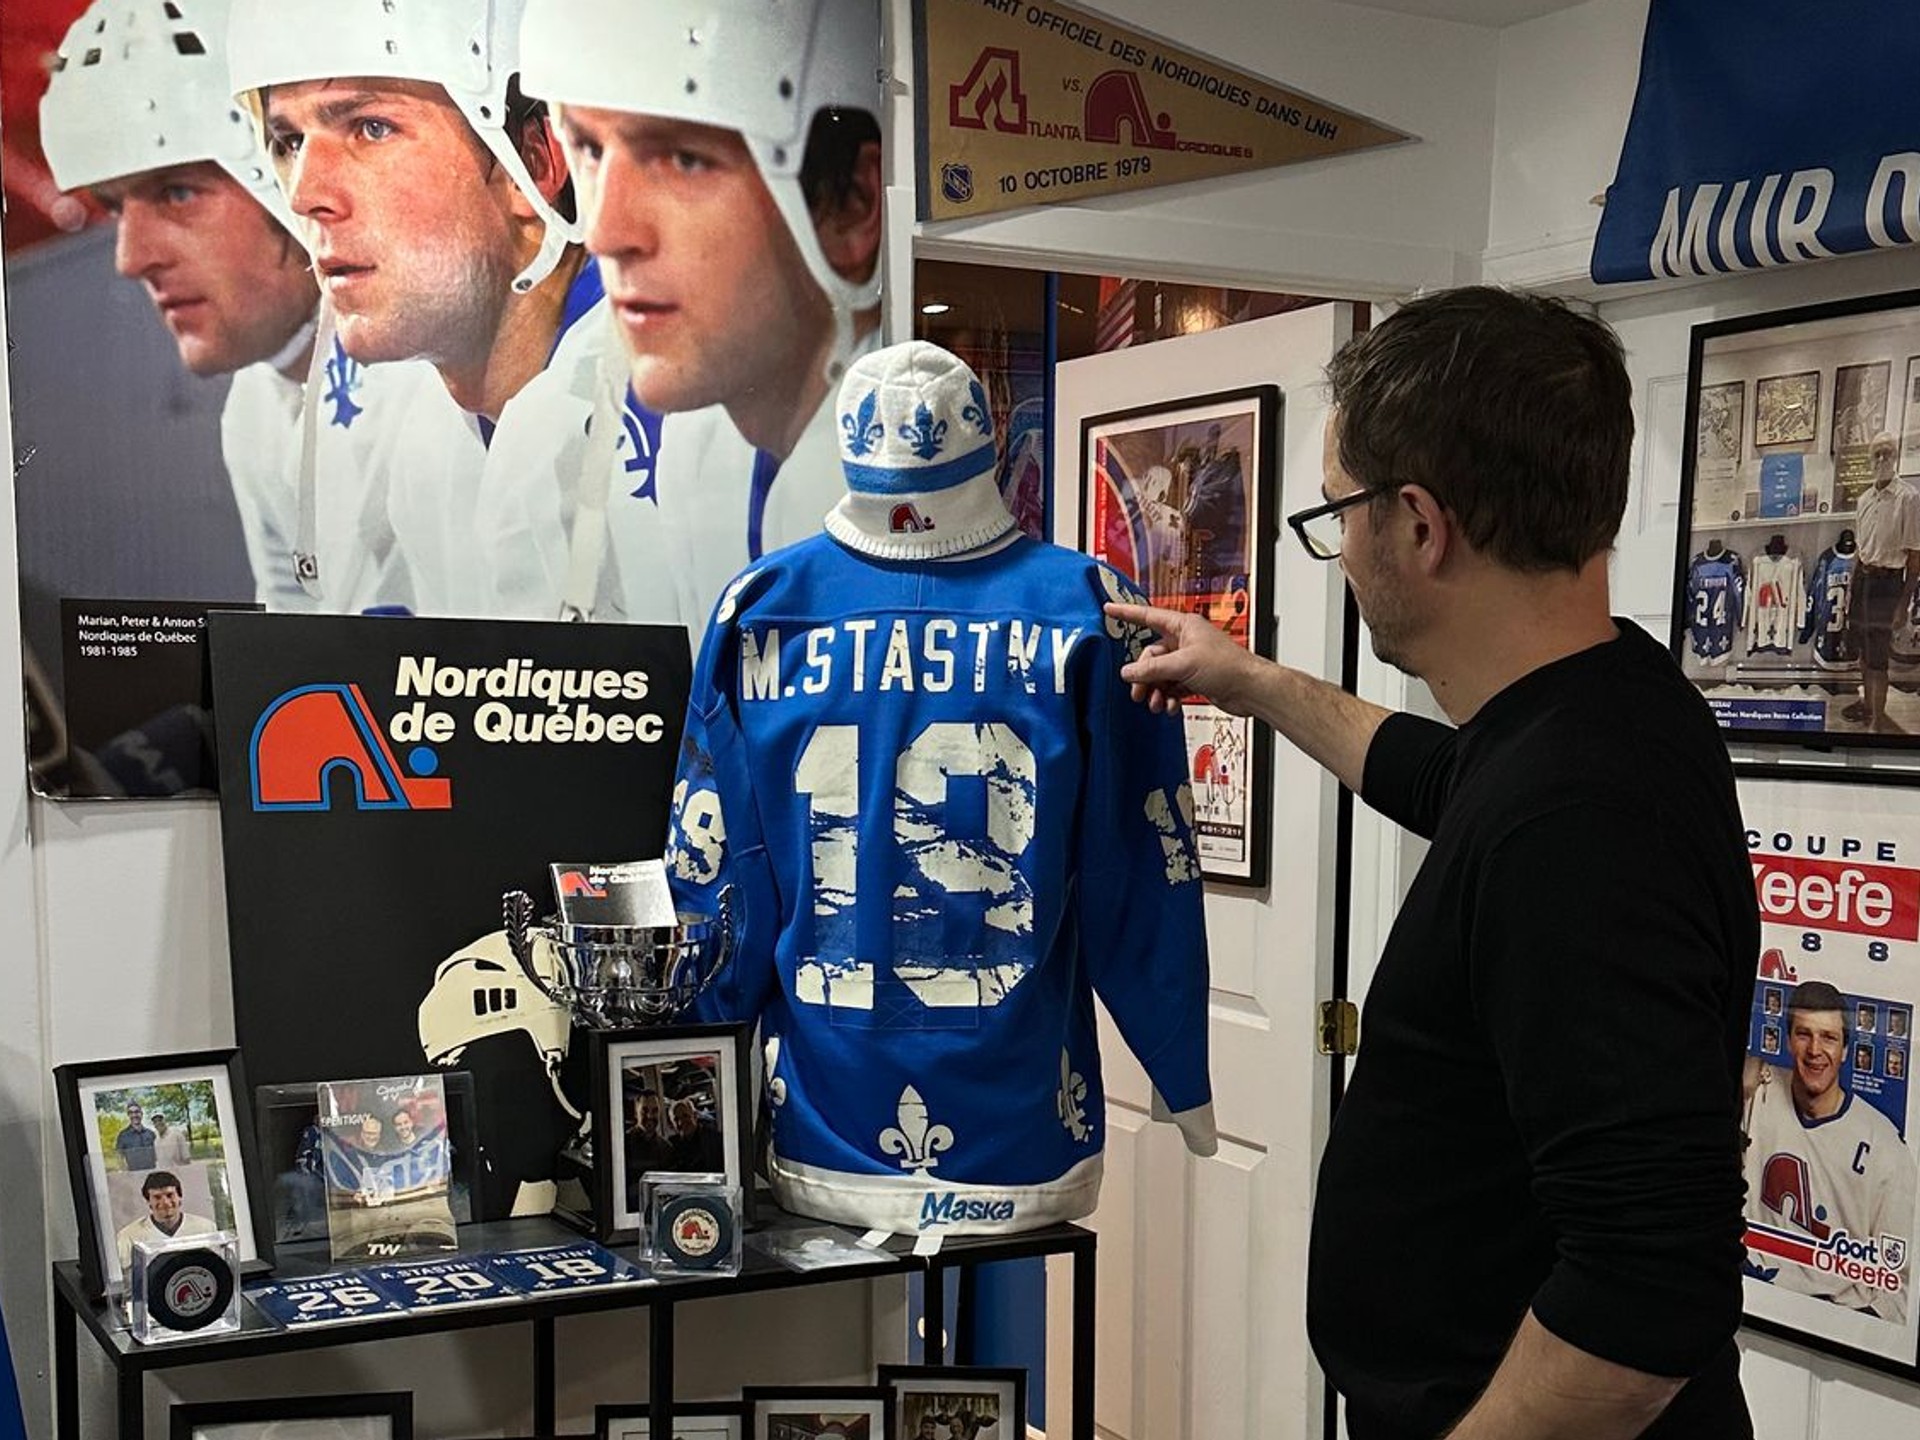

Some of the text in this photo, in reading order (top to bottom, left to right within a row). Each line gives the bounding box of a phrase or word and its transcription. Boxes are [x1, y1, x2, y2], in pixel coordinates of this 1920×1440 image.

[1026, 6, 1104, 51] OFFICIEL
[1109, 40, 1147, 67] DES
[1151, 56, 1252, 107] NORDIQUES
[1255, 97, 1302, 127] DANS
[1304, 115, 1338, 140] LNH
[999, 156, 1152, 193] 10 OCTOBRE 1979
[1650, 167, 1840, 279] MUR
[78, 615, 206, 628] Marian, Peter & Anton S
[79, 630, 197, 643] Nordiques de Québec
[81, 646, 138, 656] 1981-1985
[395, 656, 649, 705] Nordiques
[389, 702, 664, 743] de Québec
[1745, 830, 1896, 862] COUPE
[1852, 1141, 1870, 1175] C
[918, 1192, 1016, 1230] Maska
[1818, 1231, 1879, 1264] Sport
[403, 1272, 495, 1295] 20
[525, 1259, 607, 1281] 18
[1816, 1250, 1899, 1291] O'Keefe
[287, 1287, 381, 1312] 26
